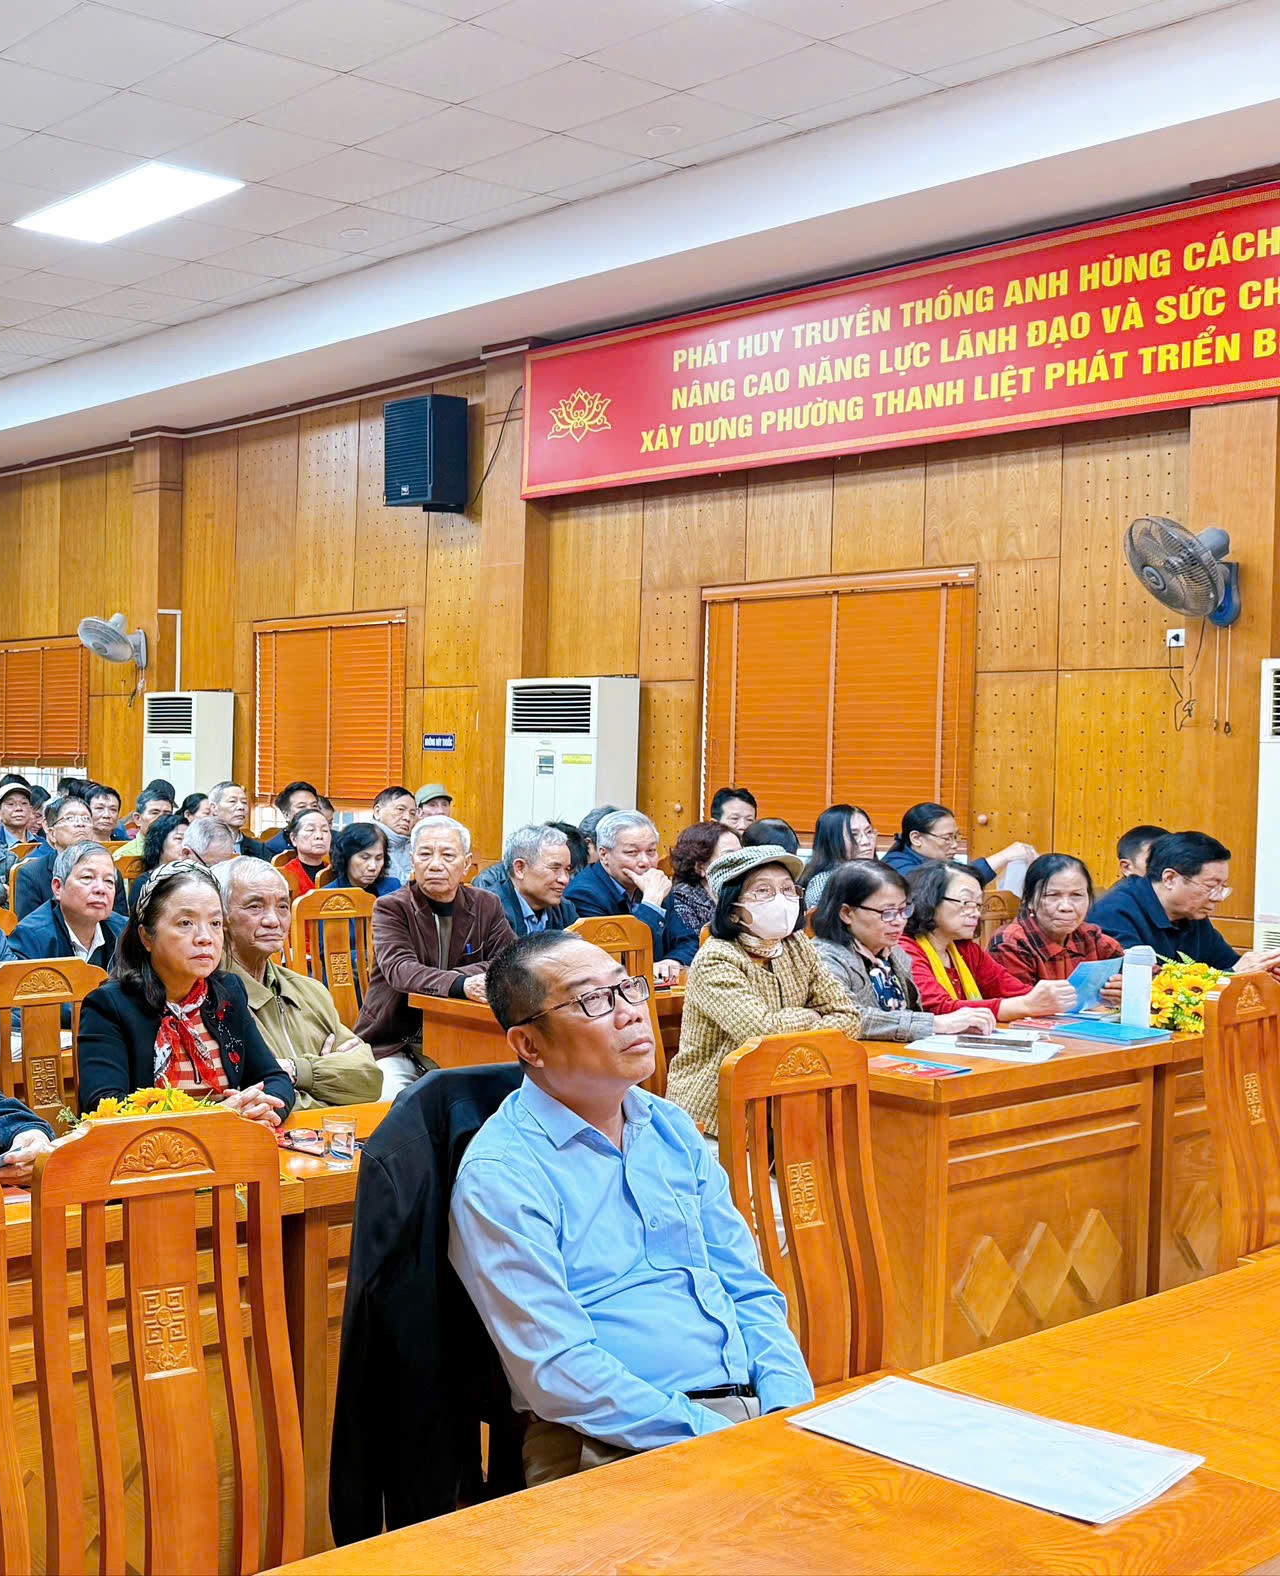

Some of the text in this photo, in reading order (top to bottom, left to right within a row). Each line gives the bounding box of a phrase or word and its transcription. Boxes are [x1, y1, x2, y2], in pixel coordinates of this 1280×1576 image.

[671, 380, 735, 411] NÂNG
[743, 367, 791, 398] CAO
[798, 353, 870, 389] NĂNG
[880, 342, 931, 377] LỰC
[940, 325, 1017, 364] LÃNH
[1026, 311, 1091, 349] ĐẠO
[1101, 297, 1144, 334] VÀ
[1154, 284, 1226, 325] SỨC
[673, 226, 1280, 372] PHÁT HUY TRUYỀN THỐNG ANH HÙNG CÁCH
[639, 422, 683, 454] XÂY
[690, 415, 753, 448] DỰNG
[761, 395, 864, 435] PHƯỜNG
[872, 379, 965, 417] THANH
[974, 365, 1035, 403] LIỆT
[1045, 347, 1129, 391] PHÁT
[1138, 325, 1241, 375] TRIỂN
